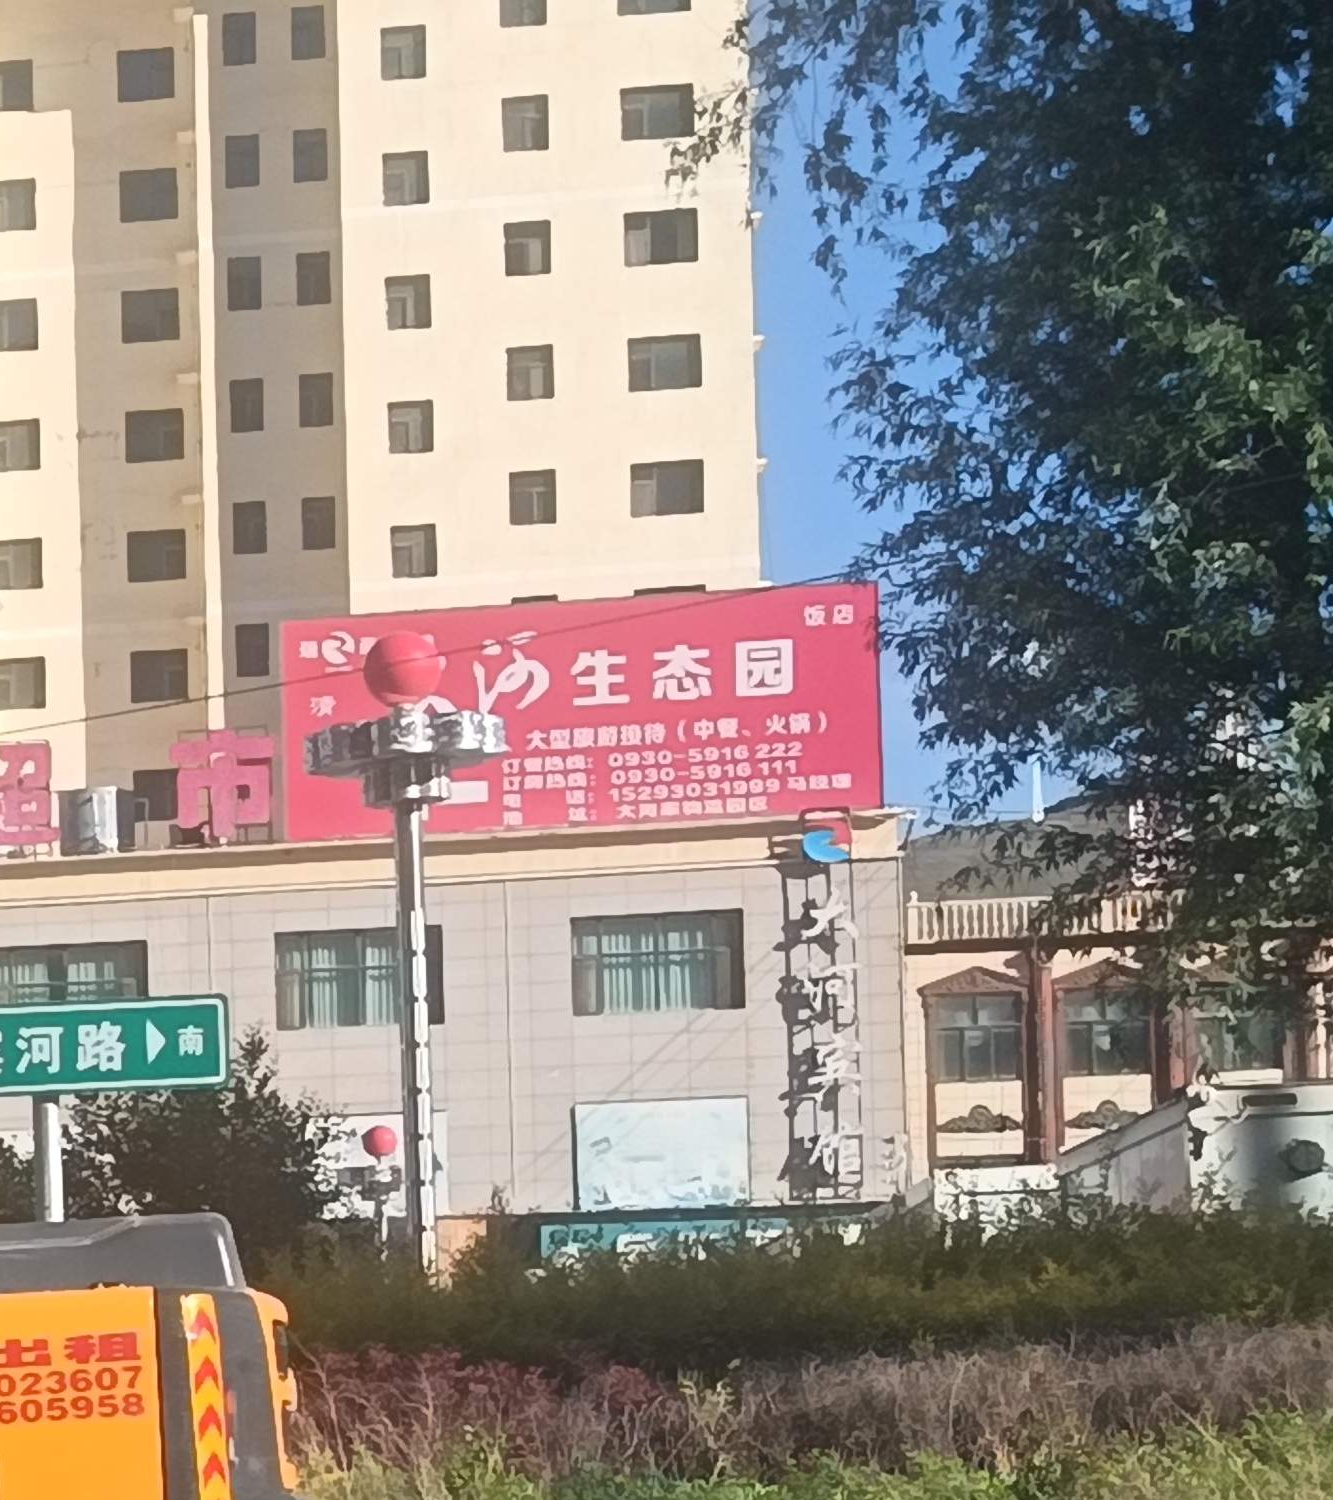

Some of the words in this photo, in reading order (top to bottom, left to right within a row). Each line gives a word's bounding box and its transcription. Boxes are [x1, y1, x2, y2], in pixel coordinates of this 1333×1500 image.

[803, 604, 854, 627] 饭店
[607, 744, 749, 768] 0930-5916
[754, 741, 803, 759] 222
[759, 759, 798, 776] 111
[176, 1025, 204, 1057] 南
